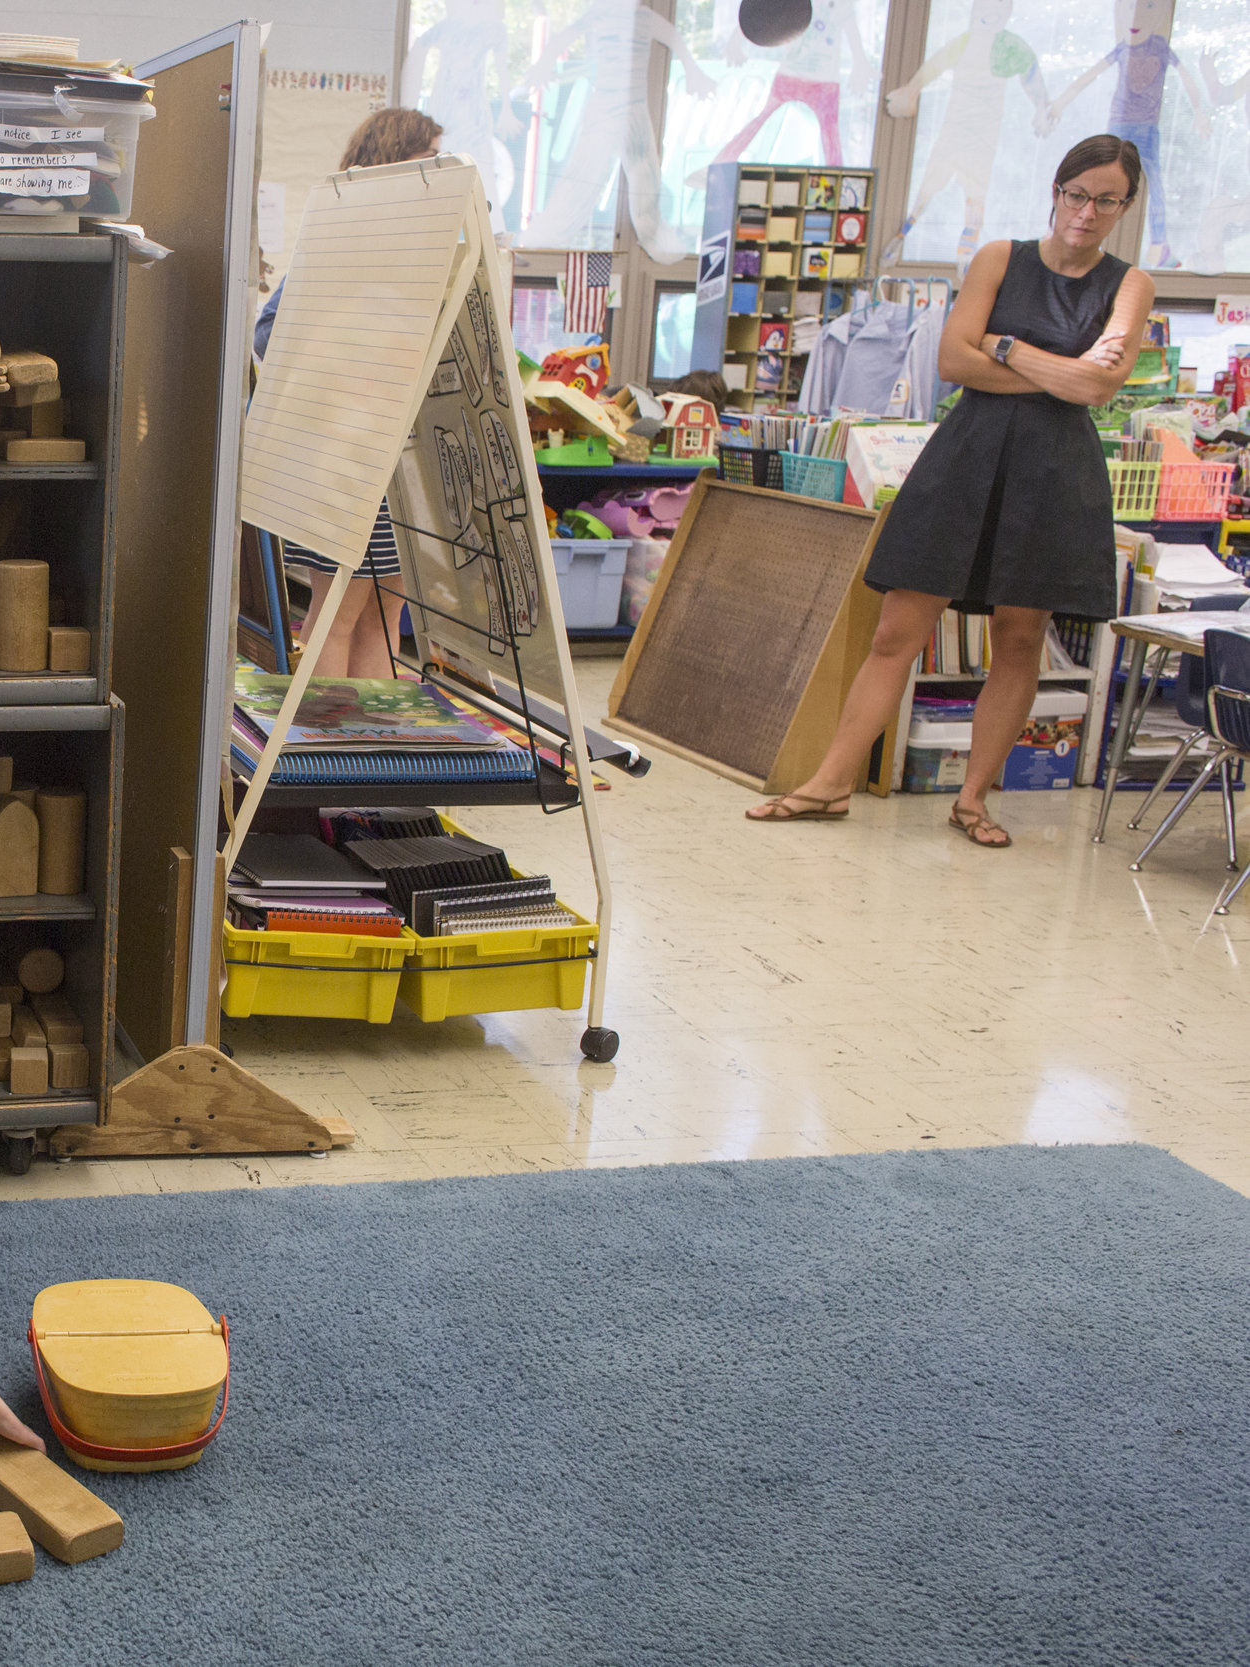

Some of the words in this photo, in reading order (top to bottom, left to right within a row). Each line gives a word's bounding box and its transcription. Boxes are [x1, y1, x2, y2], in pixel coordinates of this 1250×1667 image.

[4, 128, 31, 140] notice
[51, 130, 60, 140] I
[66, 129, 82, 139] see
[0, 177, 12, 186] are
[16, 174, 53, 193] showing
[486, 427, 499, 465] gym
[495, 421, 515, 470] party
[1060, 742, 1066, 753] 1
